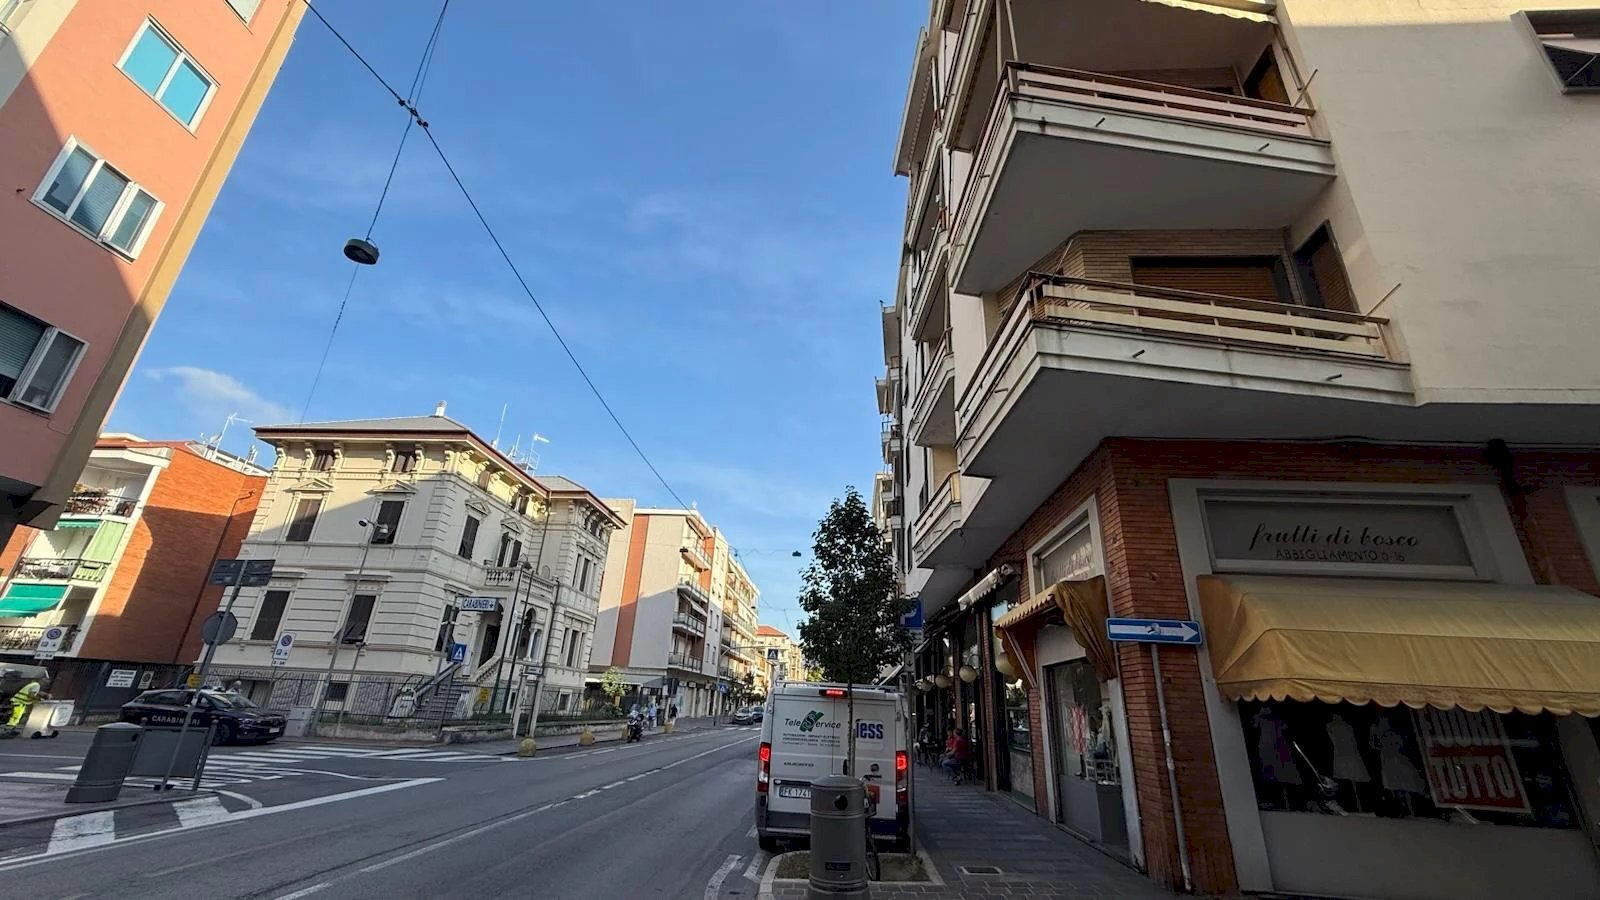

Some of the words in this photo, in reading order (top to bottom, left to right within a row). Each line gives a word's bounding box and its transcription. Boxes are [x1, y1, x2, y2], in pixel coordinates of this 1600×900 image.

[1249, 522, 1319, 551] frutti
[1327, 526, 1352, 545] di
[1360, 526, 1418, 547] bosco
[1275, 549, 1377, 561] ABBIGLIAMENTO
[463, 598, 489, 609] CARABINIERI
[151, 715, 200, 726] CARABINRI
[1431, 753, 1517, 800] TUTTO
